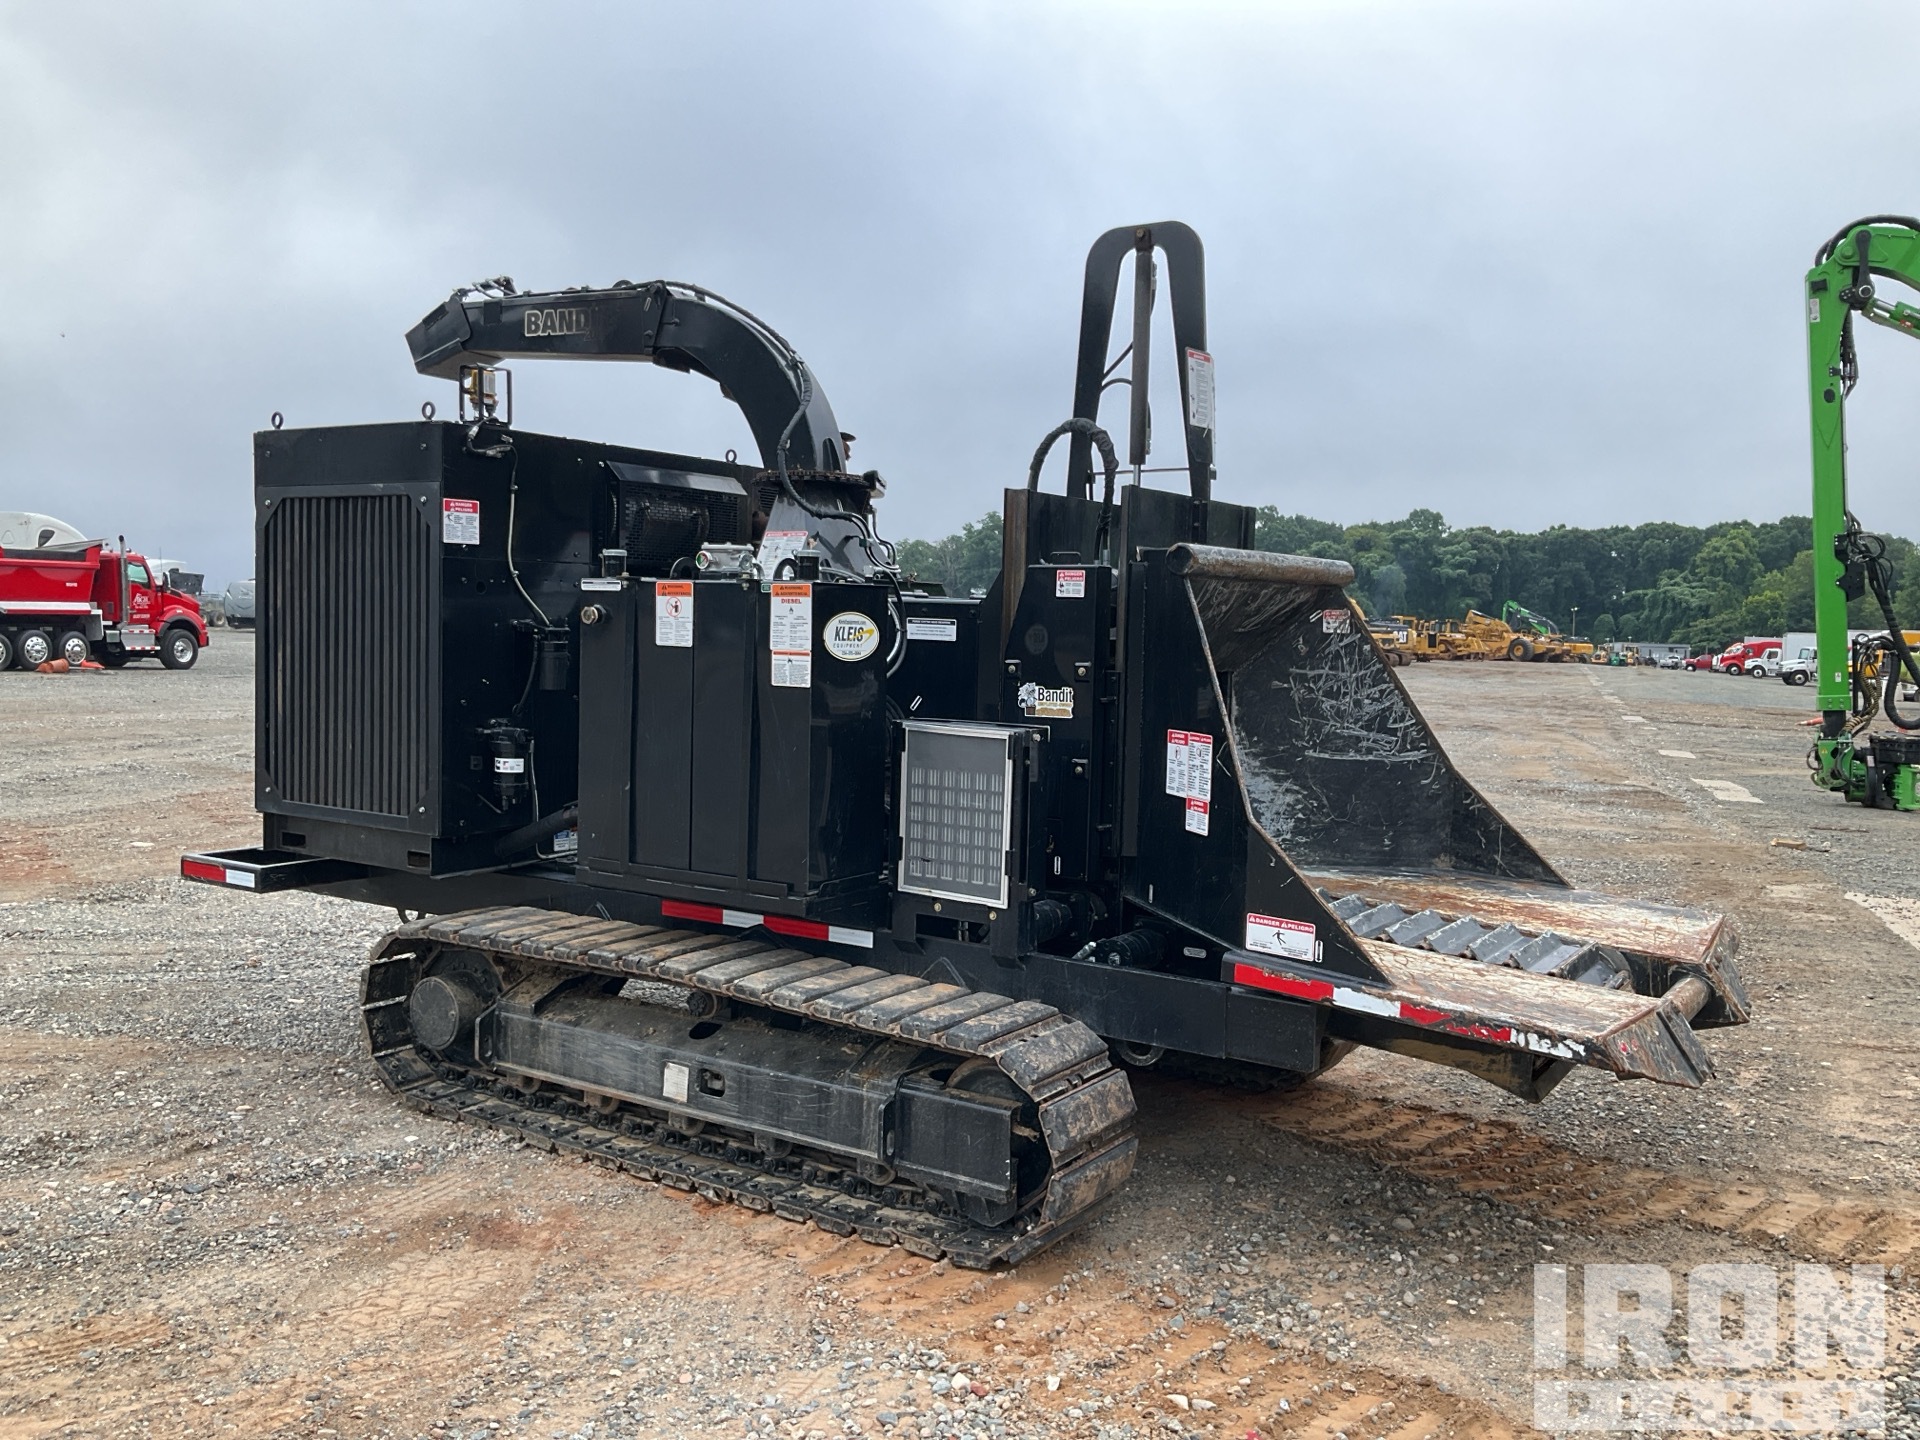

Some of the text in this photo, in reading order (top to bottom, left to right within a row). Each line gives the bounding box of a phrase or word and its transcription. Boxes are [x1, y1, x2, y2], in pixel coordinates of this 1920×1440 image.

[834, 626, 864, 642] KLEIS
[1038, 687, 1072, 702] Bandit
[1255, 918, 1314, 932] DANGER PELIGRO
